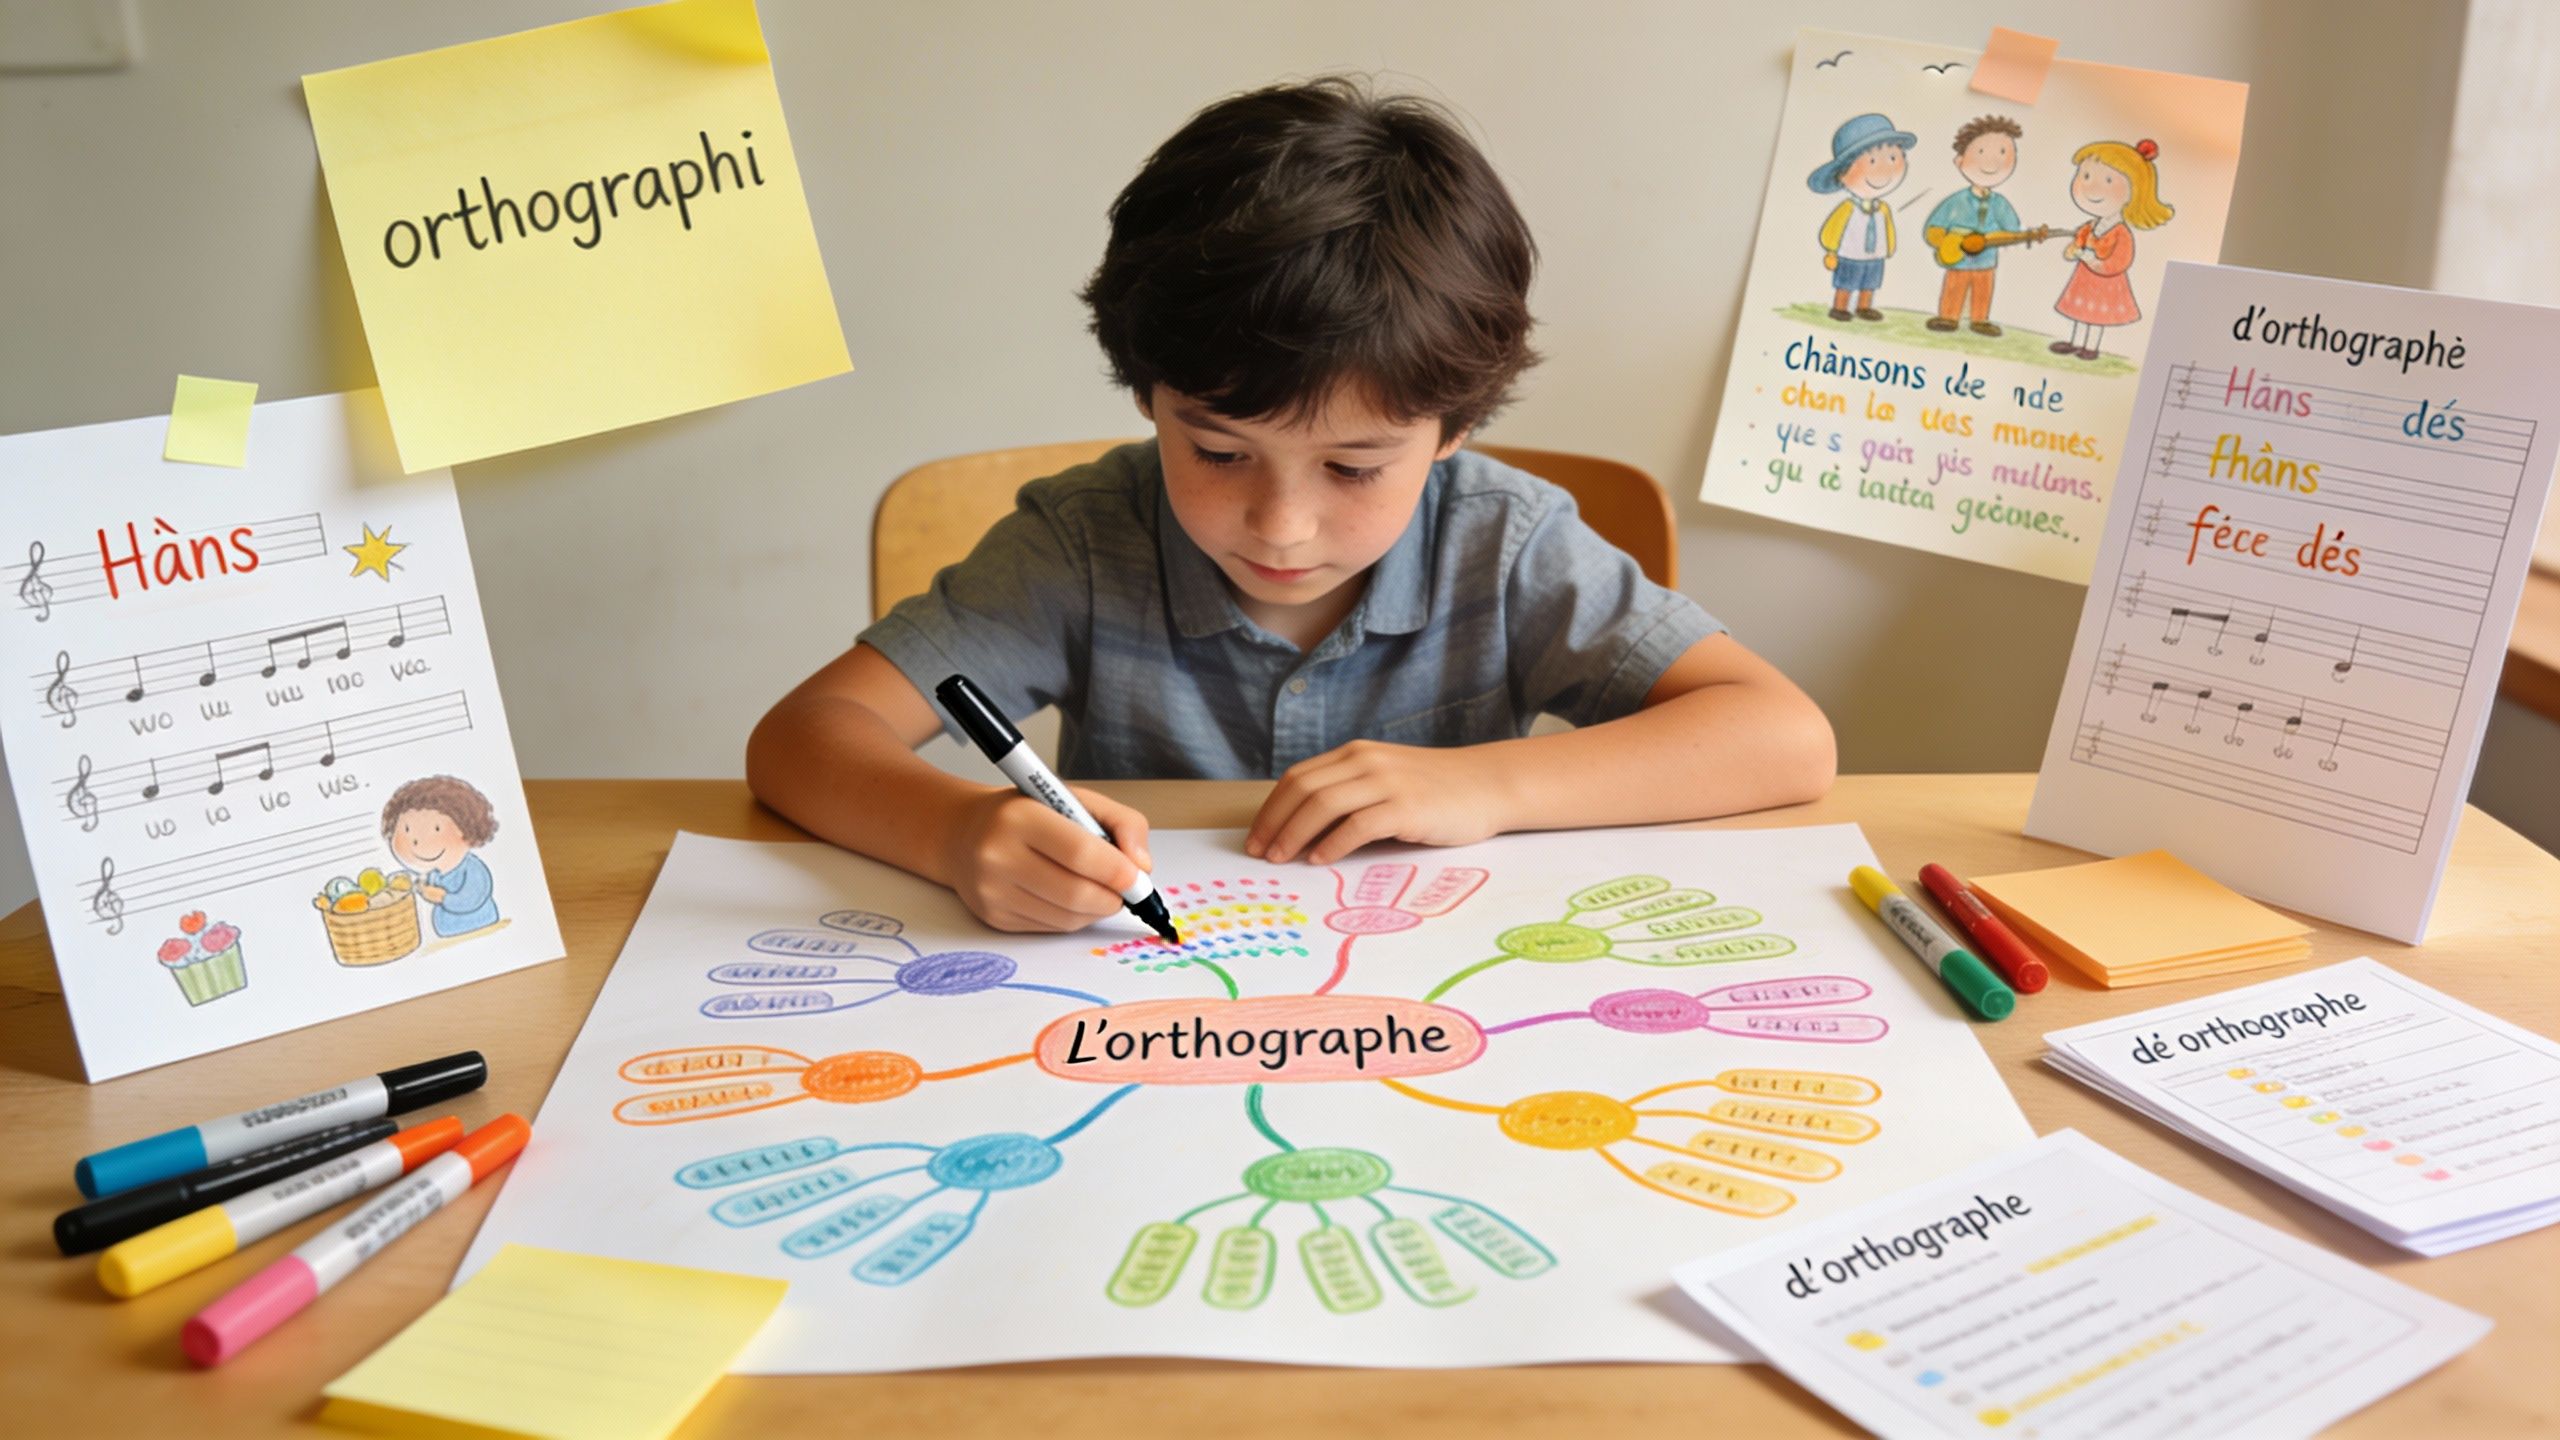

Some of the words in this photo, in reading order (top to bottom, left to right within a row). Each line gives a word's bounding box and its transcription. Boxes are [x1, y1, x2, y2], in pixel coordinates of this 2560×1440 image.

[383, 130, 765, 269] orthographi
[2402, 399, 2466, 441] dés
[97, 517, 260, 600] Hàns
[2297, 522, 2361, 578] dés
[1063, 1014, 1452, 1070] L'orthographe
[2178, 992, 2367, 1053] orthographe
[1786, 1195, 2032, 1299] d'orthographe
